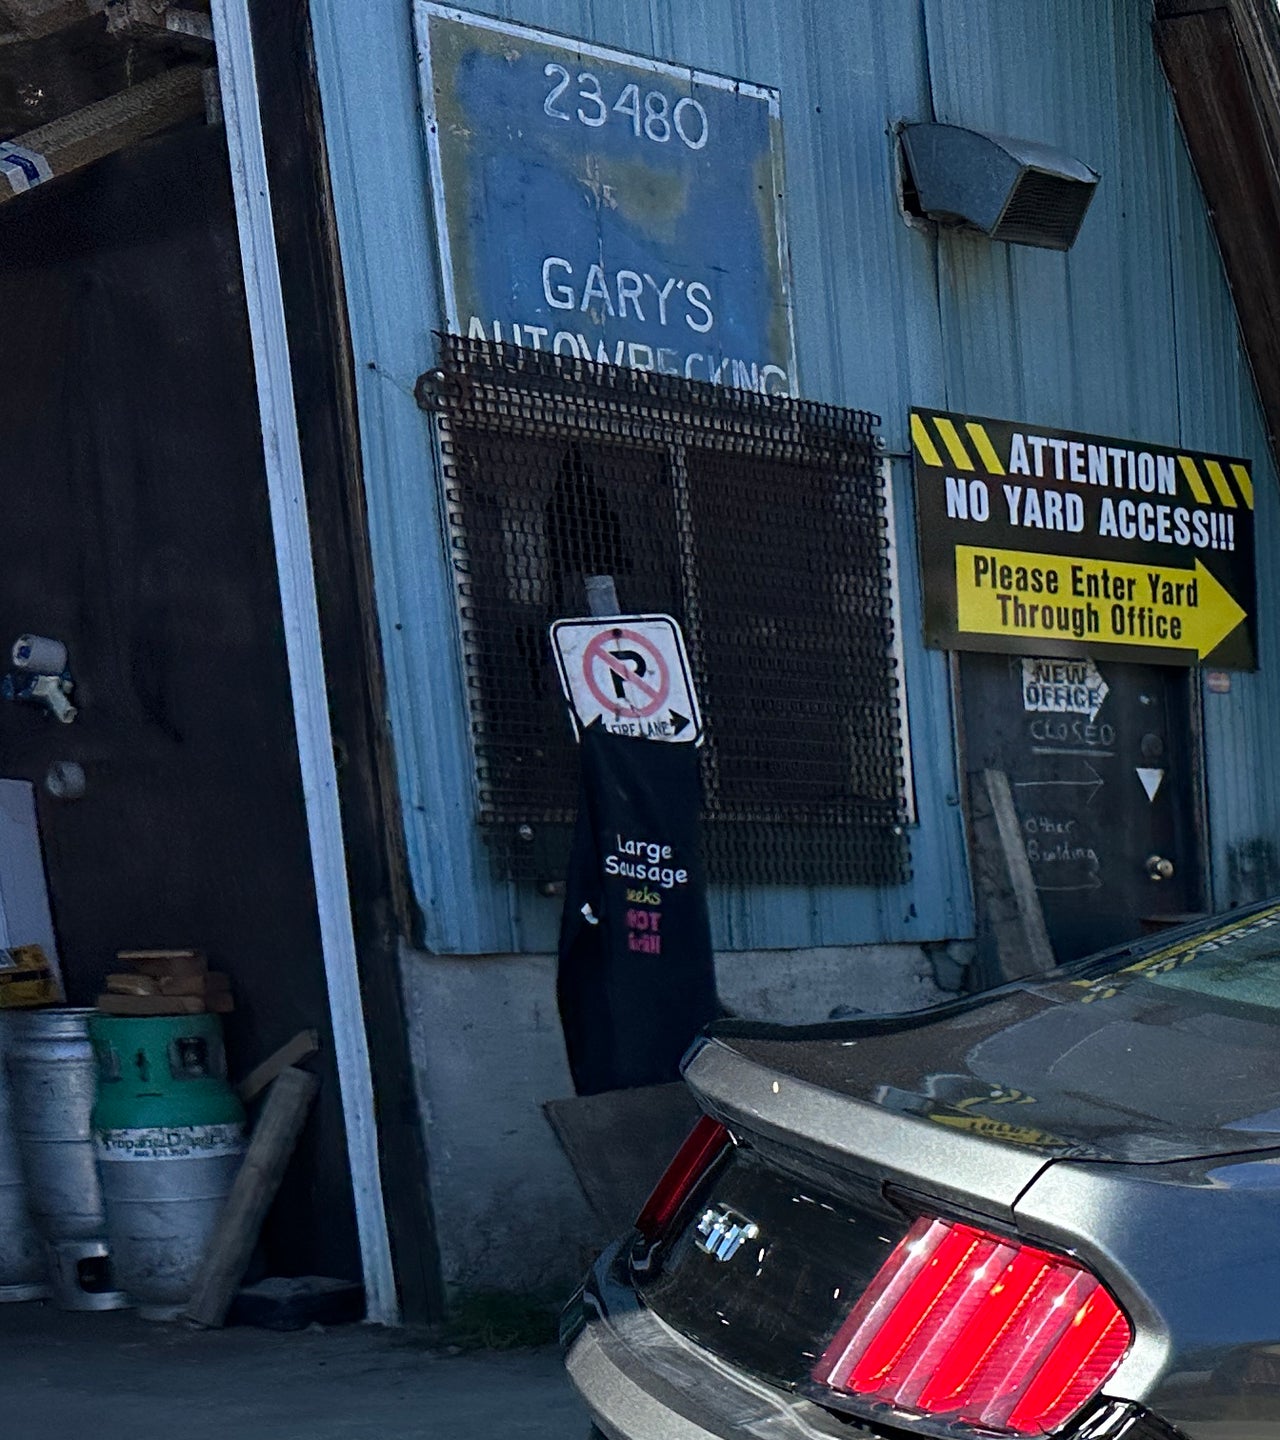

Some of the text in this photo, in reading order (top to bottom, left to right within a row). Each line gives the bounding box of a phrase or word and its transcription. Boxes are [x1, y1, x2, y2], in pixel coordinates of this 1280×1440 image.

[543, 63, 709, 150] 23480
[541, 256, 714, 333] GARY'S
[1009, 432, 1176, 495] ATTENTION
[945, 477, 1235, 551] NO YARD ACCESS!!!
[973, 554, 1198, 607] Please Enter Yard
[996, 594, 1181, 639] Through Office
[1026, 683, 1101, 708] OFFICE
[1035, 663, 1086, 684] NEW
[1030, 720, 1116, 746] CLOSED
[617, 834, 672, 863] Large
[605, 855, 688, 888] Sausage
